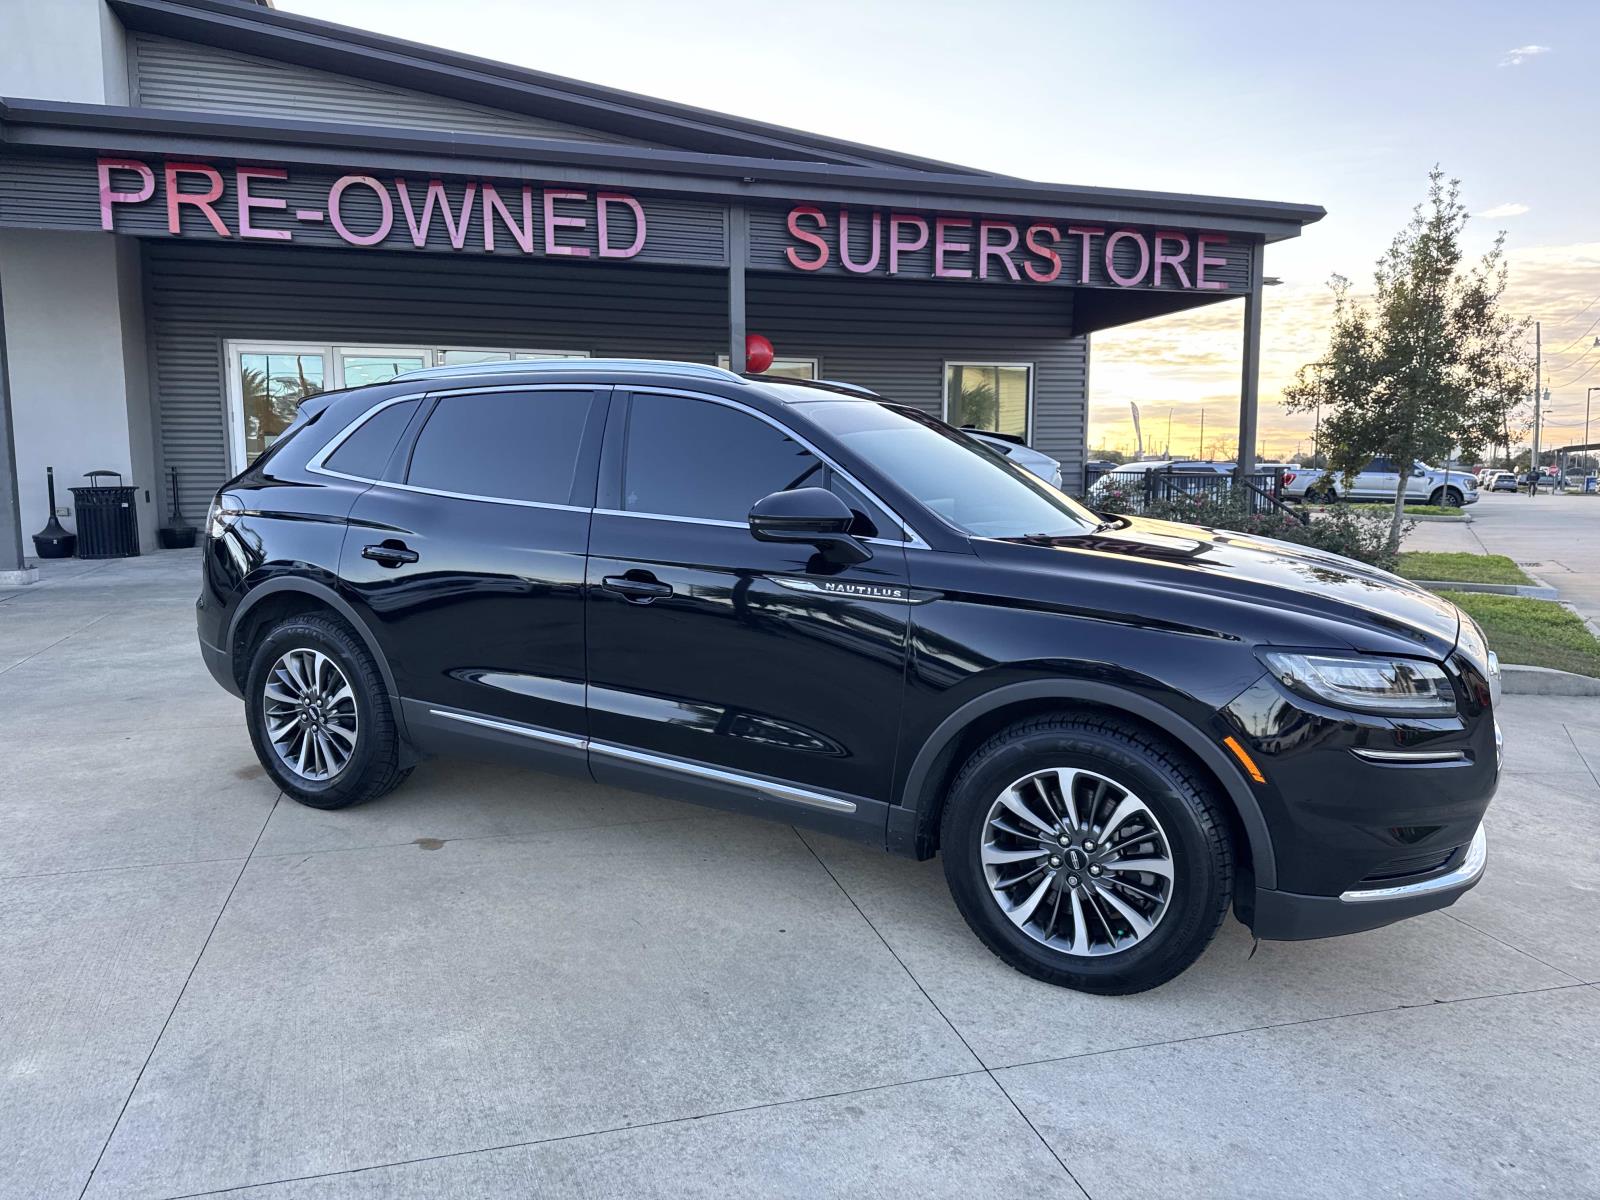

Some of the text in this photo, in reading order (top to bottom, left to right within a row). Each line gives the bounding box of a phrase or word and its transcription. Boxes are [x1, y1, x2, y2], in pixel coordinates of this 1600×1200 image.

[97, 157, 1230, 291] PRE-OWNED SUPERSTORE
[825, 582, 902, 597] NAUTILUS
